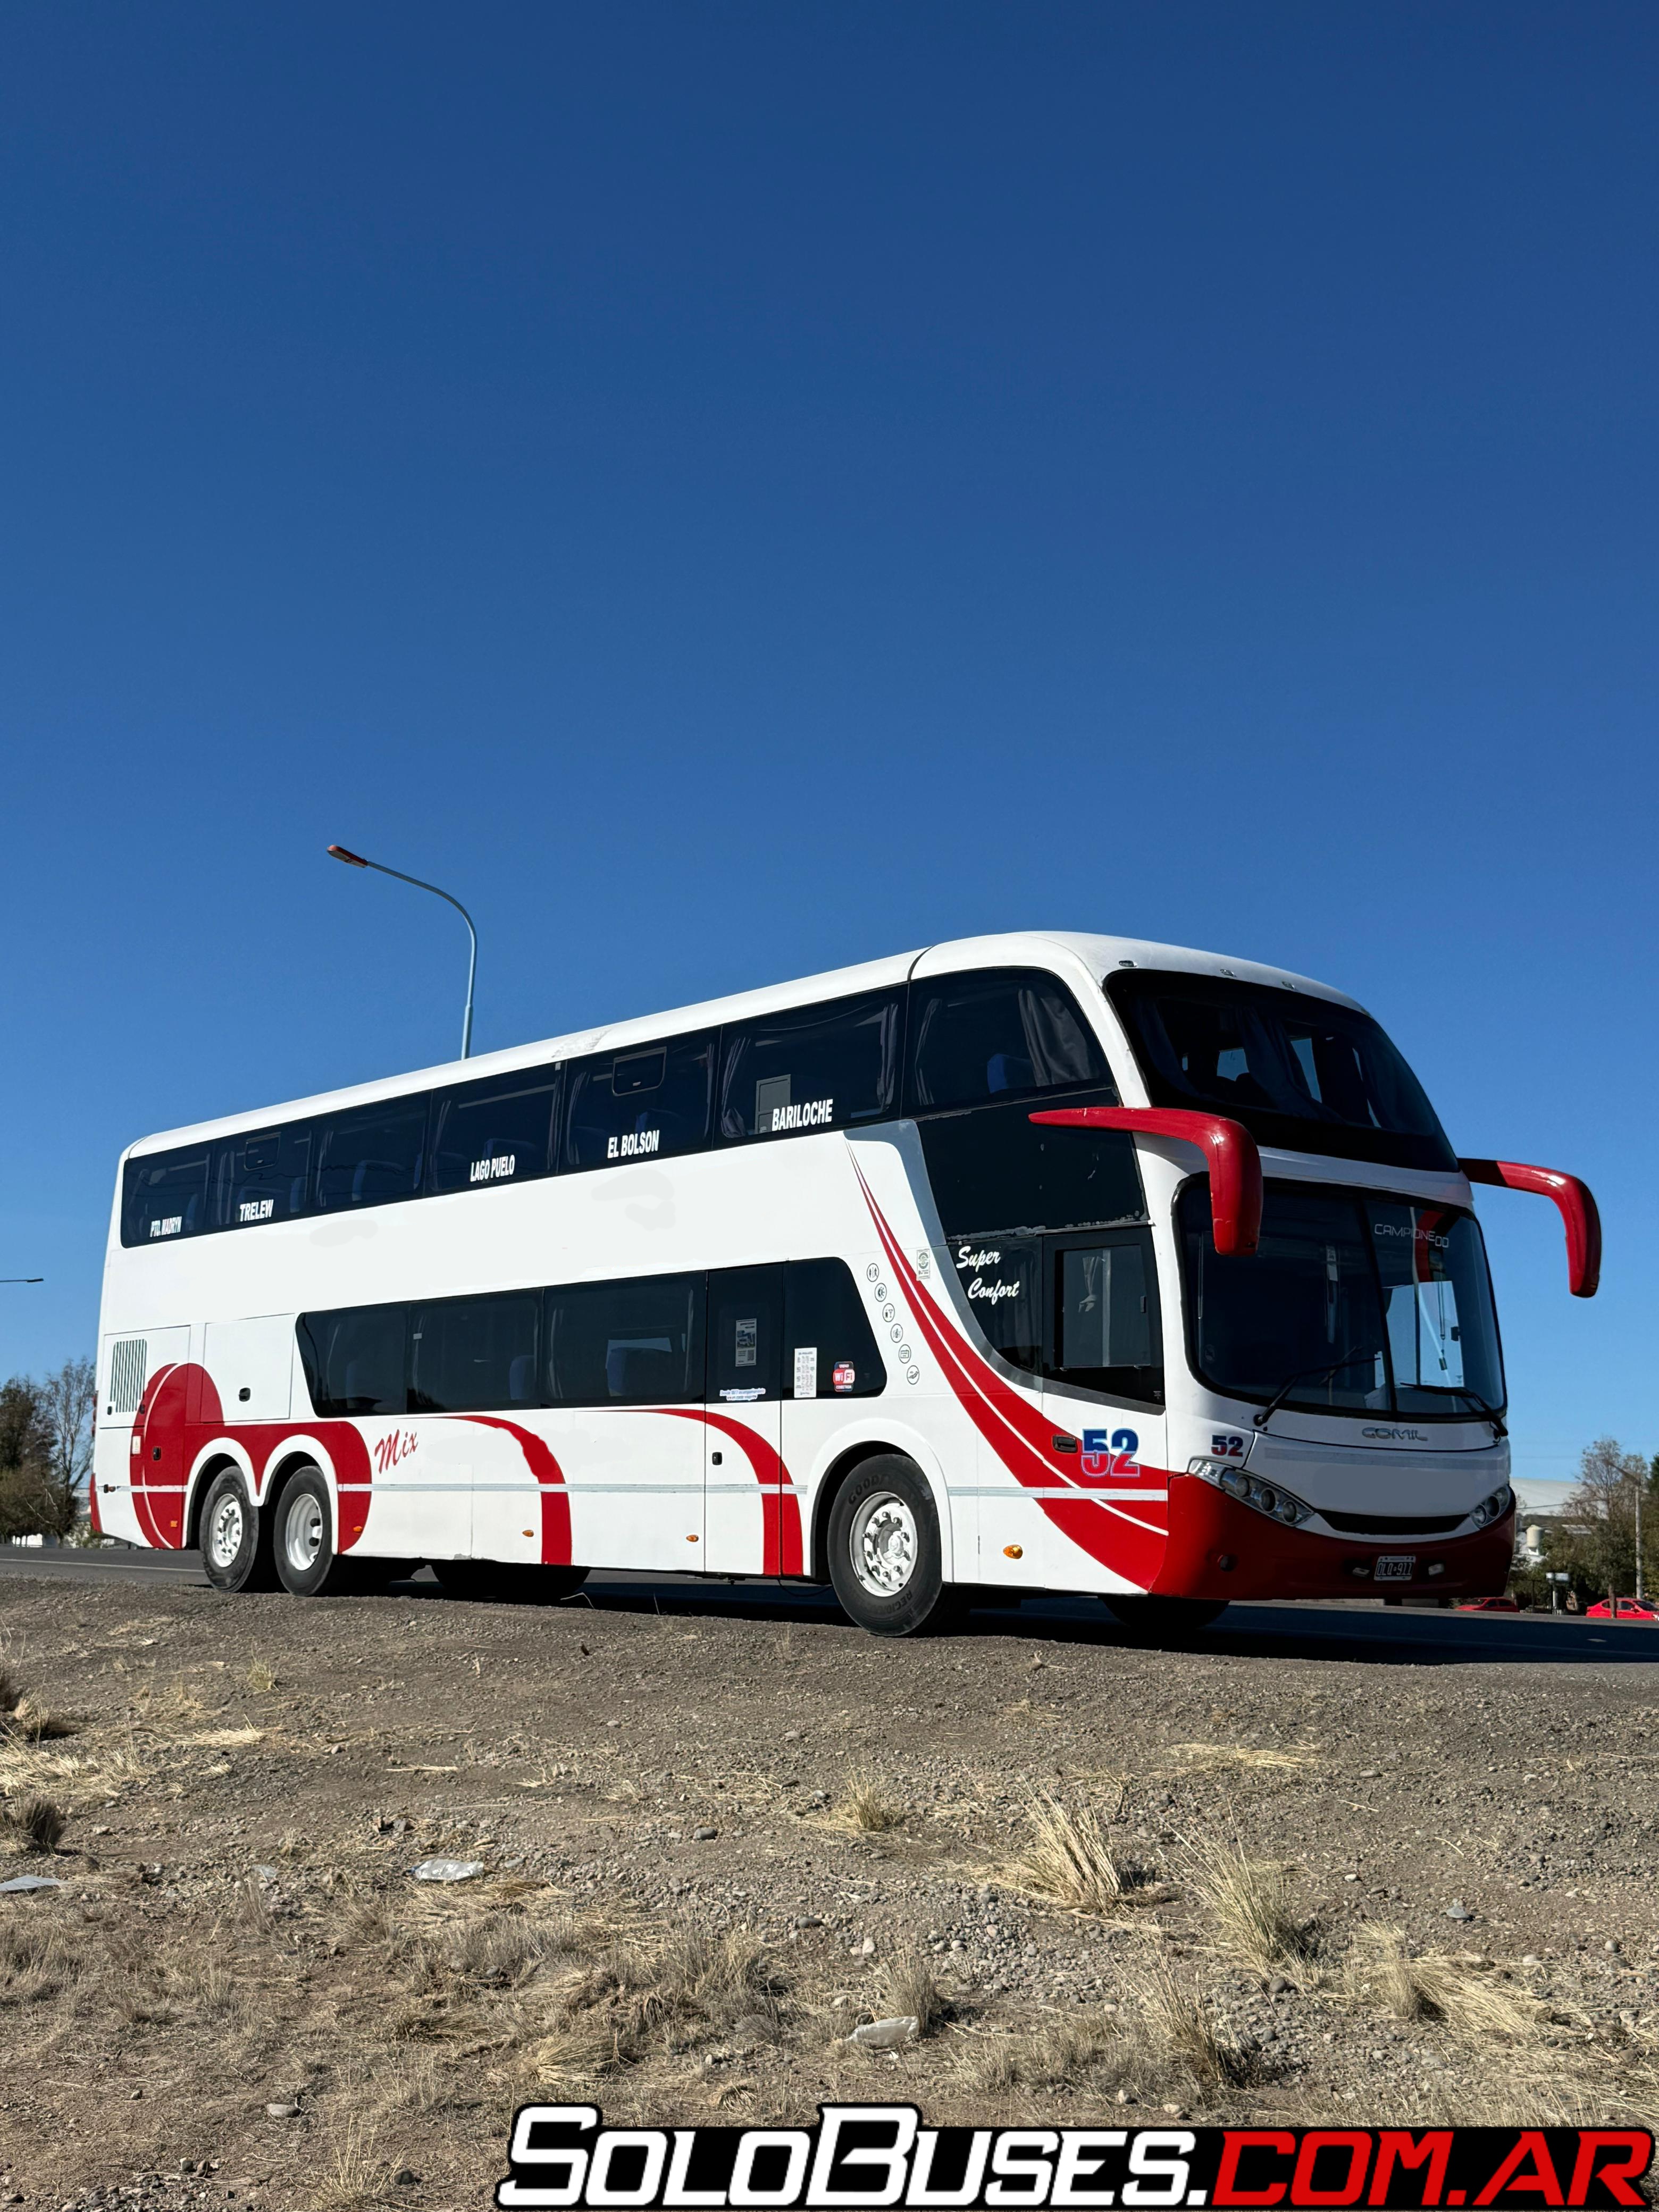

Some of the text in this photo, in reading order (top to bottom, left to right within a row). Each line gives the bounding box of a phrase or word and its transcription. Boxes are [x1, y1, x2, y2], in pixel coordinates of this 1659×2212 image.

[772, 1099, 833, 1132] BARILOCHE
[607, 1129, 659, 1159] EL BOLSON
[470, 1154, 515, 1182] LAGO PUELO
[239, 1199, 274, 1222] TRELEW
[1375, 1224, 1436, 1242] CAMPIONE
[956, 1246, 1001, 1272] Super
[968, 1277, 1020, 1305] Confort
[1211, 1435, 1244, 1457] 52
[1362, 1427, 1428, 1442] COMIL
[374, 1429, 418, 1474] Mix
[1081, 1428, 1141, 1478] 52
